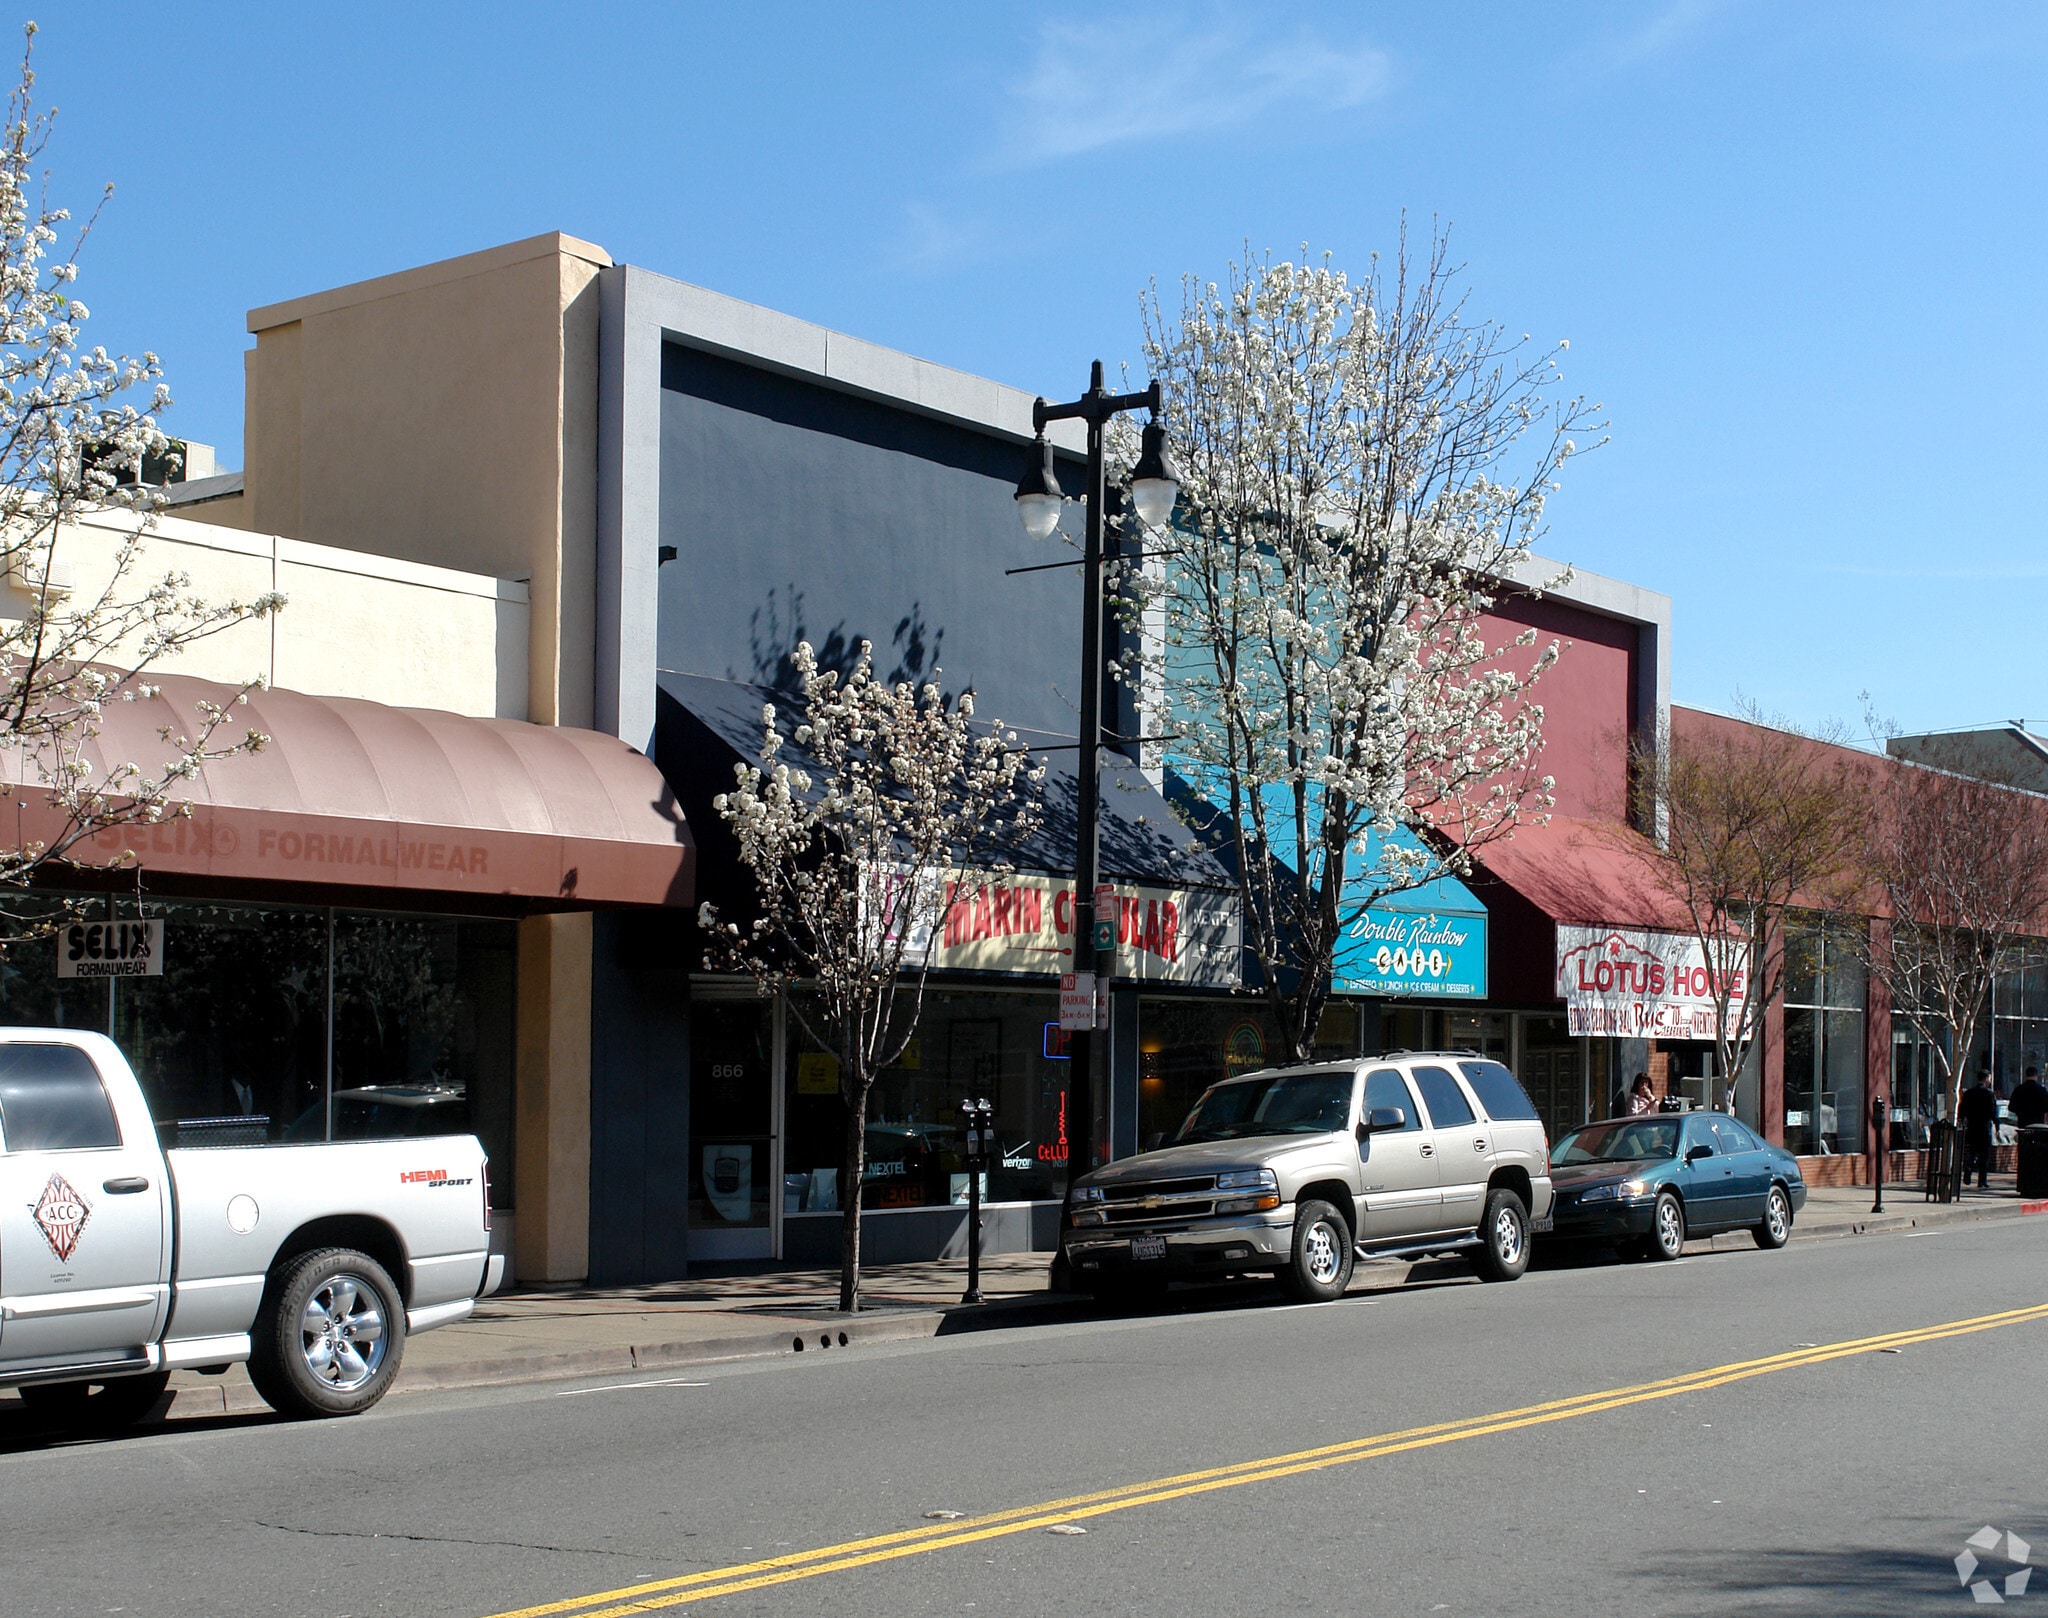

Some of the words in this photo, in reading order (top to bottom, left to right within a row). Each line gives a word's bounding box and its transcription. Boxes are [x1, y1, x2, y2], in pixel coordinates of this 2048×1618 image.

[258, 828, 489, 875] FORMALWEAR
[943, 880, 1042, 950] MARIN
[1350, 913, 1407, 943] Double
[1406, 916, 1468, 955] Rainbow
[68, 923, 151, 961] SELIX
[76, 961, 147, 976] FORMALWEAR
[1062, 977, 1075, 989] NO
[1578, 958, 1666, 995] LOTUS
[1420, 981, 1440, 993] CREAM
[1446, 982, 1470, 994] DESSERTS
[1062, 995, 1091, 1006] PARKING
[712, 1064, 744, 1078] 866
[868, 1161, 907, 1175] NEXTEL
[1002, 1156, 1033, 1169] verizon
[400, 1169, 448, 1184] HEMI
[428, 1178, 474, 1188] SPORT
[48, 1204, 75, 1221] ACC
